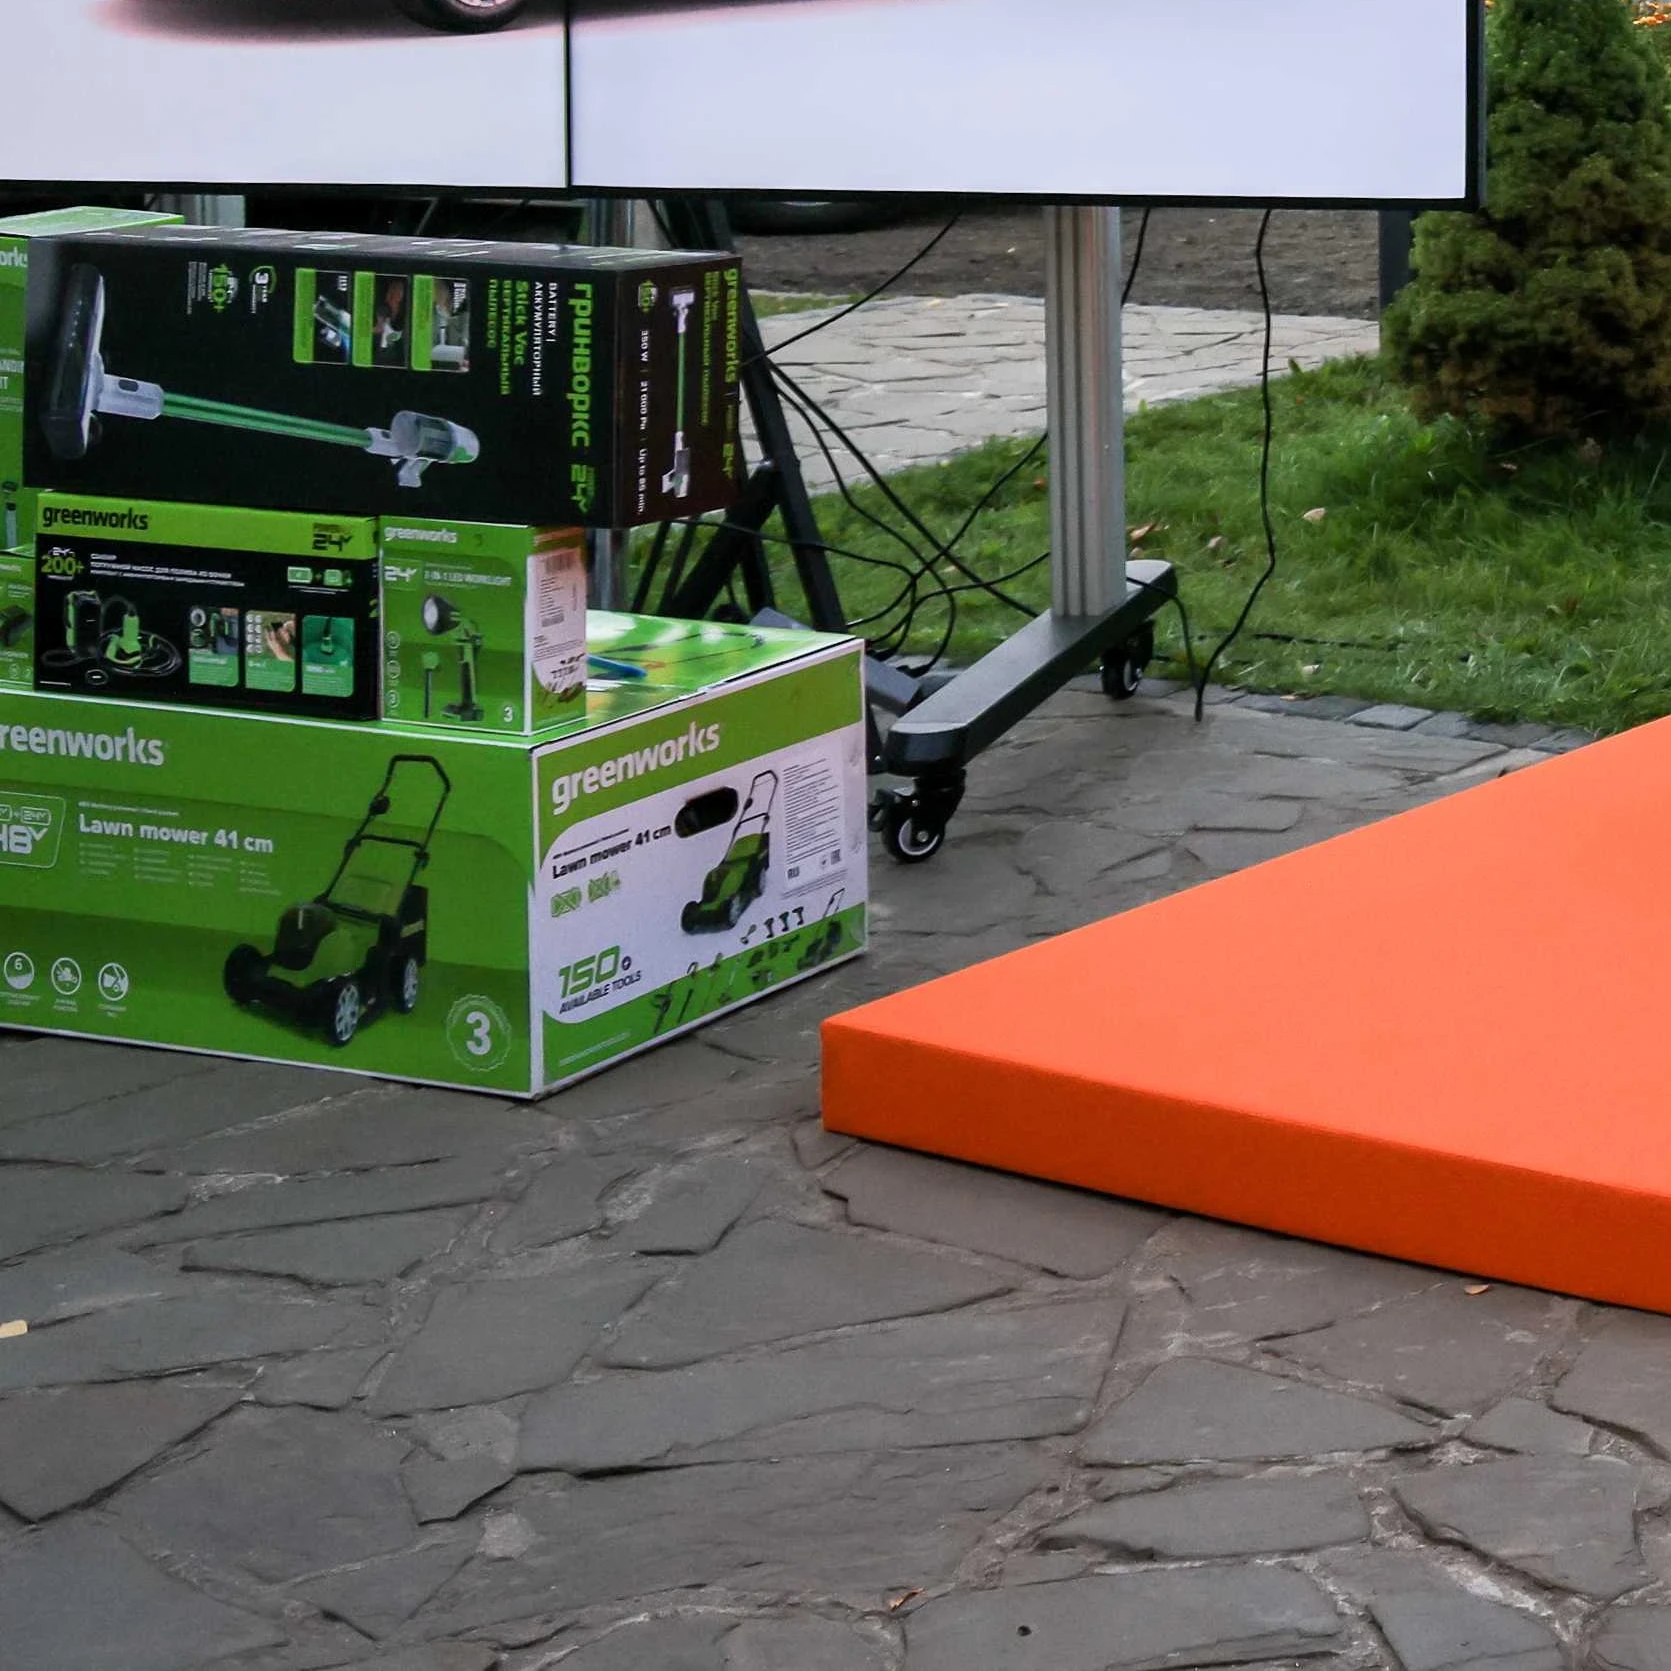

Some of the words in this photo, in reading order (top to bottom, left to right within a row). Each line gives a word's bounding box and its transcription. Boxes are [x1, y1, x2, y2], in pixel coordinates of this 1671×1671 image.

[514, 280, 529, 326] Stick
[723, 268, 739, 383] greenworks
[42, 506, 149, 530] greenworks
[384, 526, 458, 544] greenworks
[503, 705, 514, 723] 3
[551, 720, 721, 816] greenworks
[78, 813, 134, 838] Lawn
[139, 824, 209, 846] mower
[213, 828, 239, 850] 41
[243, 836, 274, 854] cm
[552, 857, 587, 880] Lawn
[589, 839, 633, 865] mower
[635, 829, 650, 846] 41
[653, 825, 672, 841] cm
[559, 982, 611, 1015] AVAILABLE
[465, 1010, 491, 1056] 3
